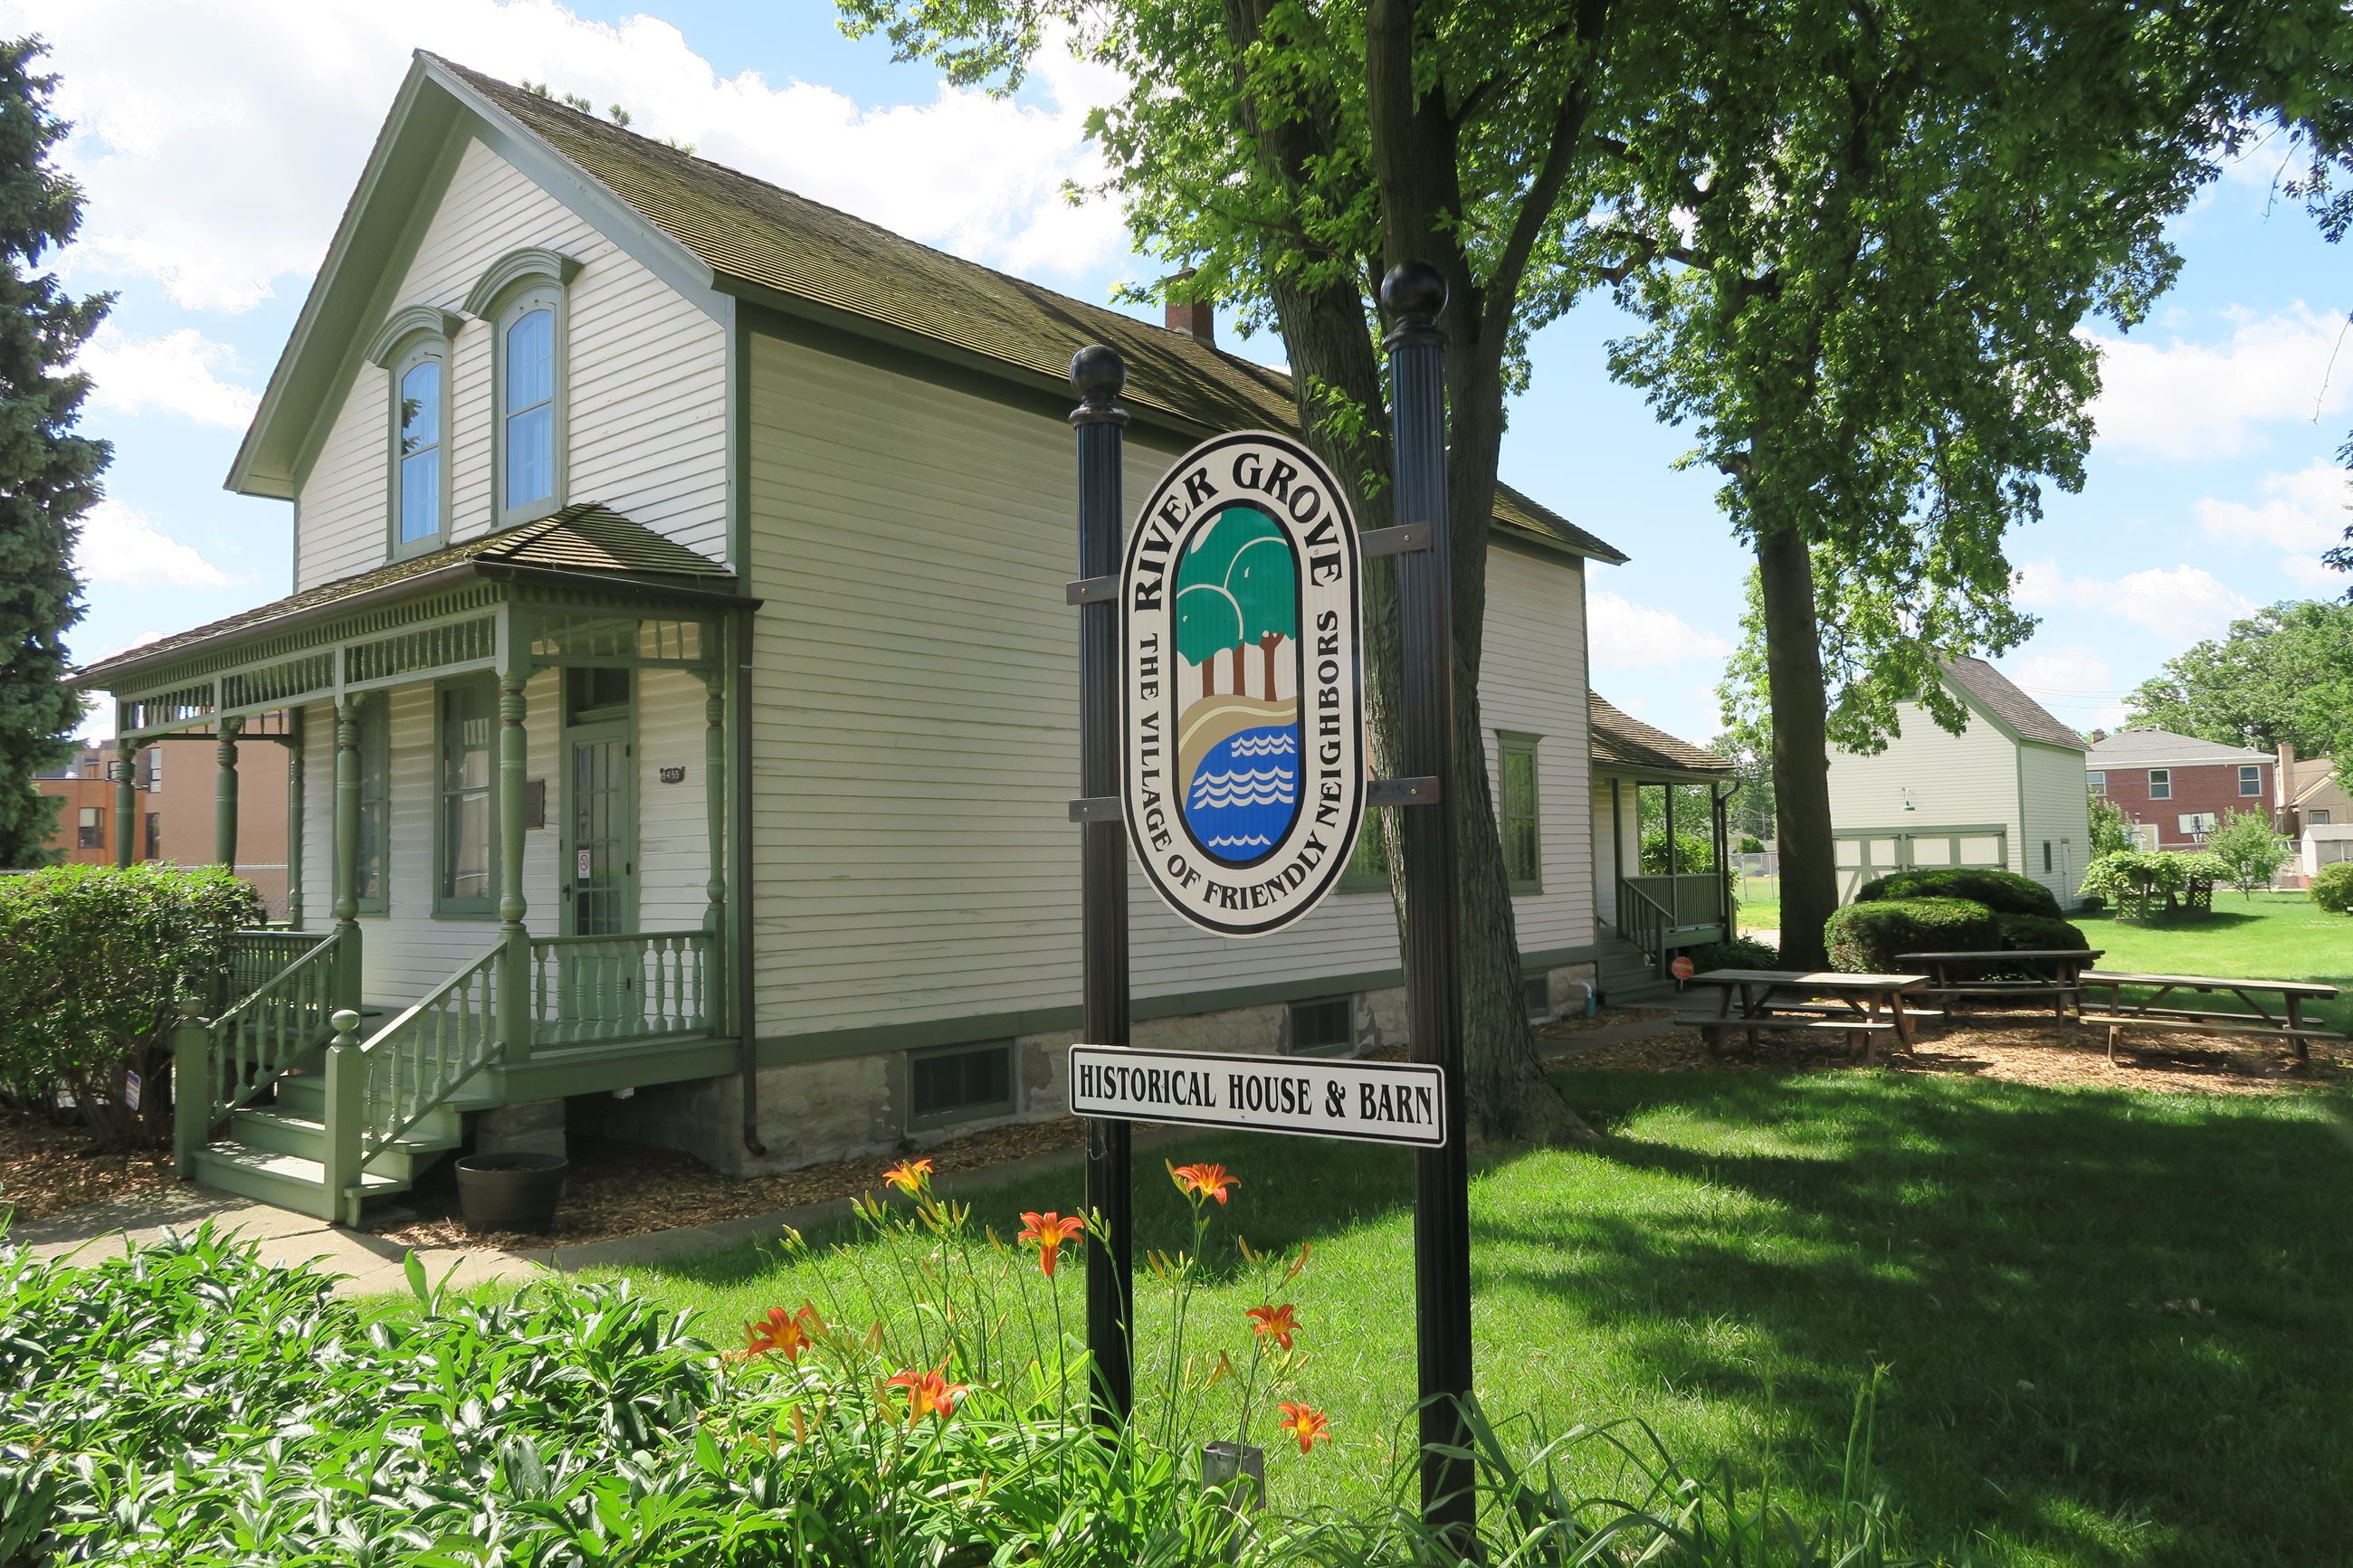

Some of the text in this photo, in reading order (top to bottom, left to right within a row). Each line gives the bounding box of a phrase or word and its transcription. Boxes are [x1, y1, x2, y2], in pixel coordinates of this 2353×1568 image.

[1134, 452, 1343, 613] RIVER GROVE
[1139, 610, 1342, 911] THE VILLAGE OF FRIENDLY NEIGHBORS
[1080, 1064, 1434, 1126] HISTORICAL HOUSE & BARN
